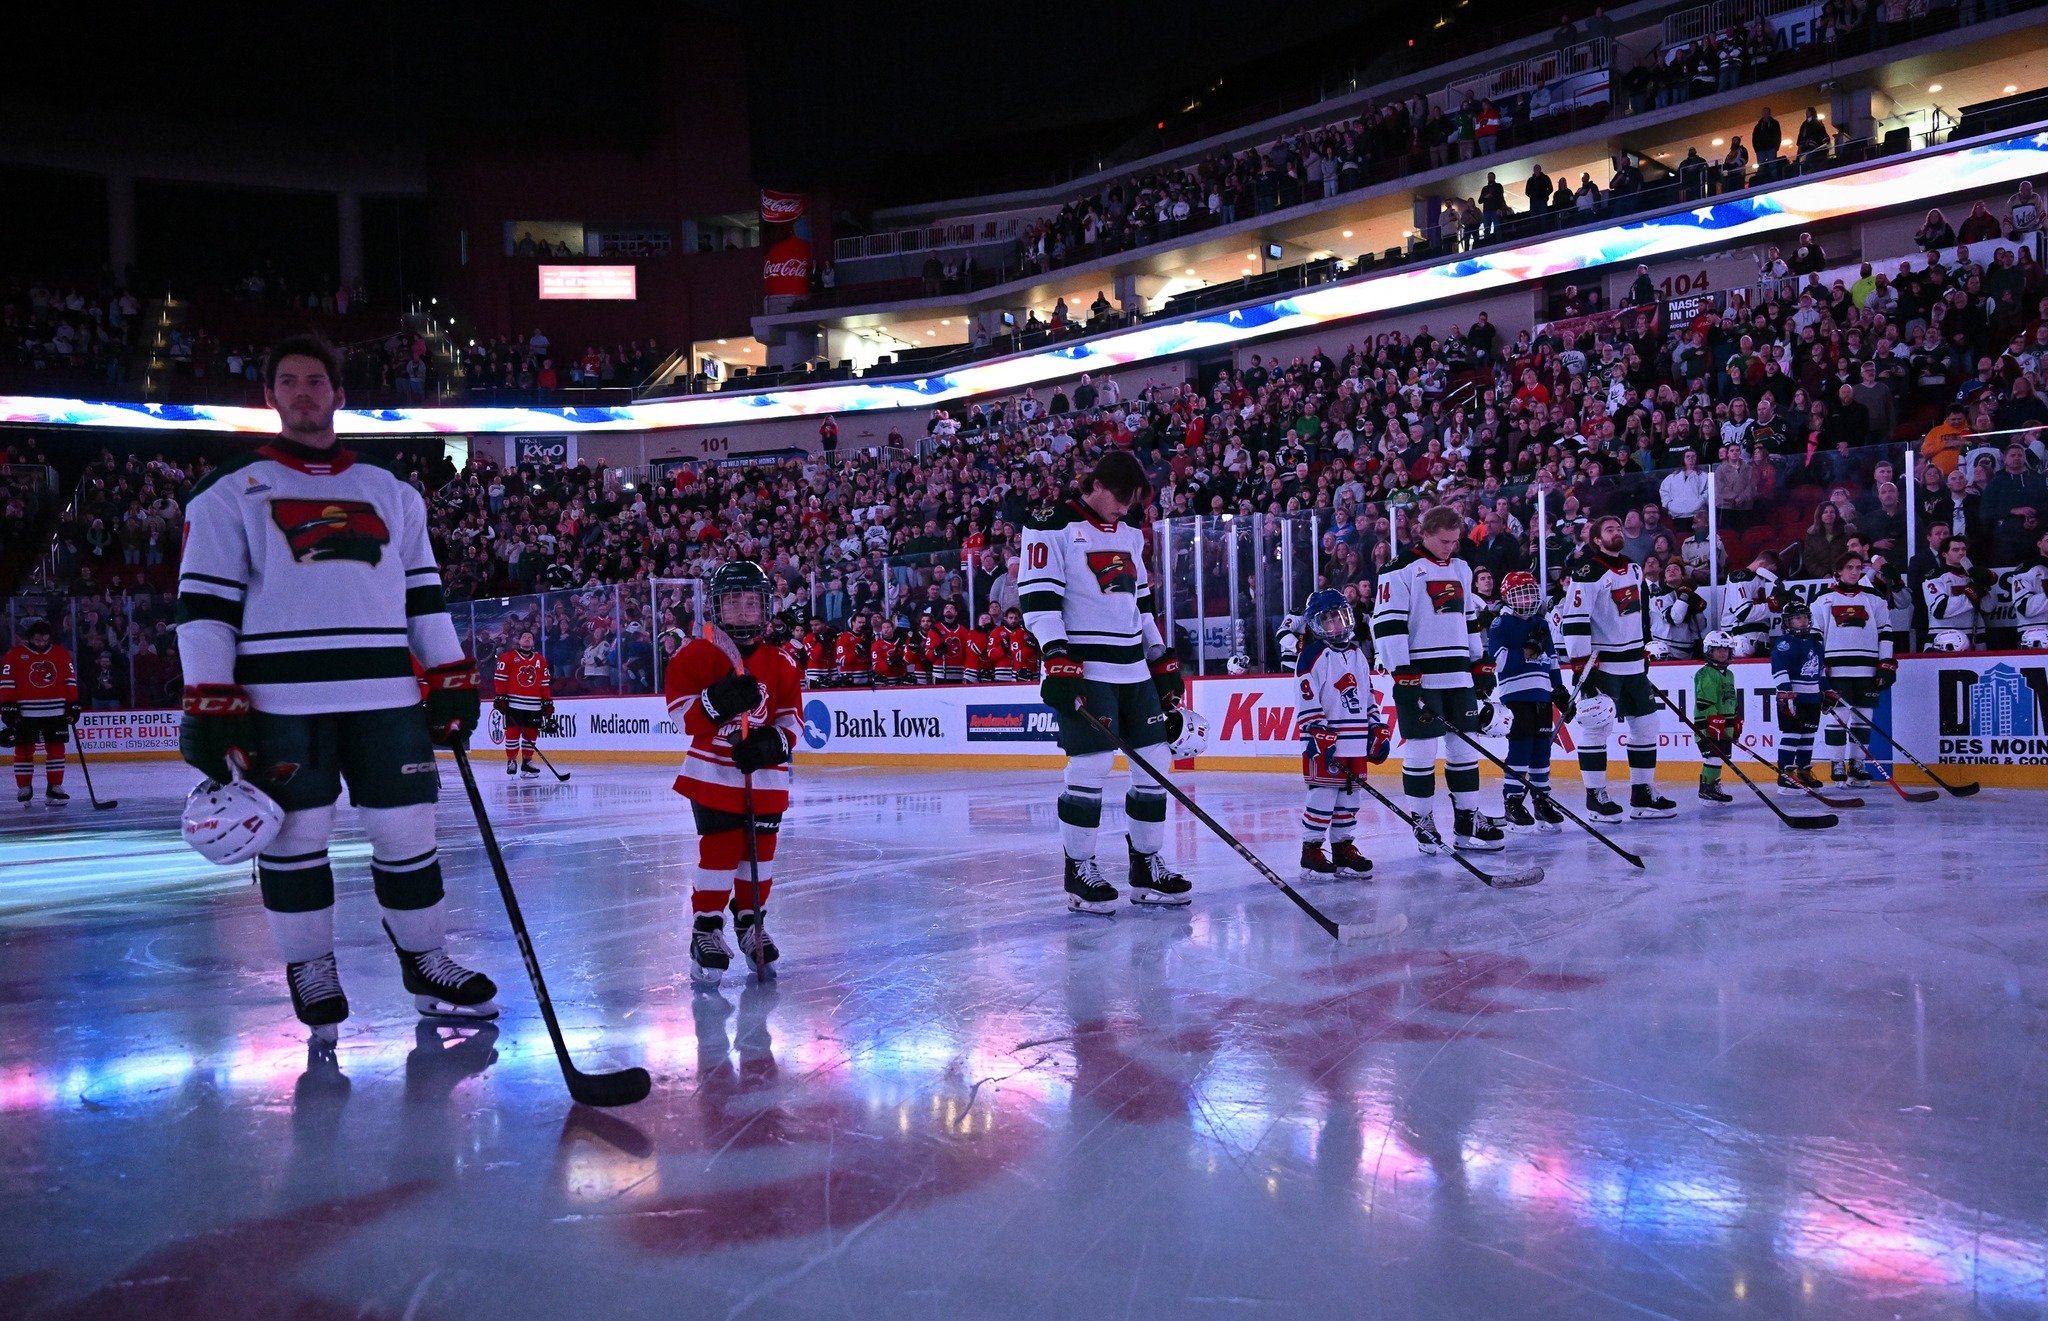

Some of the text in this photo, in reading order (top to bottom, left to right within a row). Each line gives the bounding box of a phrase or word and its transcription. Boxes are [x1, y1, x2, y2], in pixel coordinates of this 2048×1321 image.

[764, 259, 808, 279] Coca-Cola
[1660, 270, 1709, 297] 104
[1669, 295, 1714, 311] NASCR
[1670, 312, 1682, 320] IN
[700, 438, 728, 452] 101
[1027, 542, 1048, 570] 10
[1379, 582, 1390, 604] 14
[1927, 583, 1938, 594] 3
[1574, 590, 1582, 608] 5
[535, 660, 541, 669] A
[1300, 679, 1314, 700] 9
[182, 697, 250, 712] CCM
[84, 714, 176, 726] BETTER PEOPLE.
[590, 713, 650, 734] Mediacom
[835, 710, 886, 738] Bank
[76, 726, 180, 739] BETTER BUILT
[1315, 732, 1338, 741] CC
[1940, 739, 1983, 754] DES
[1939, 756, 1999, 764] HEATING
[2004, 756, 2014, 764] &
[401, 762, 437, 774] CC
